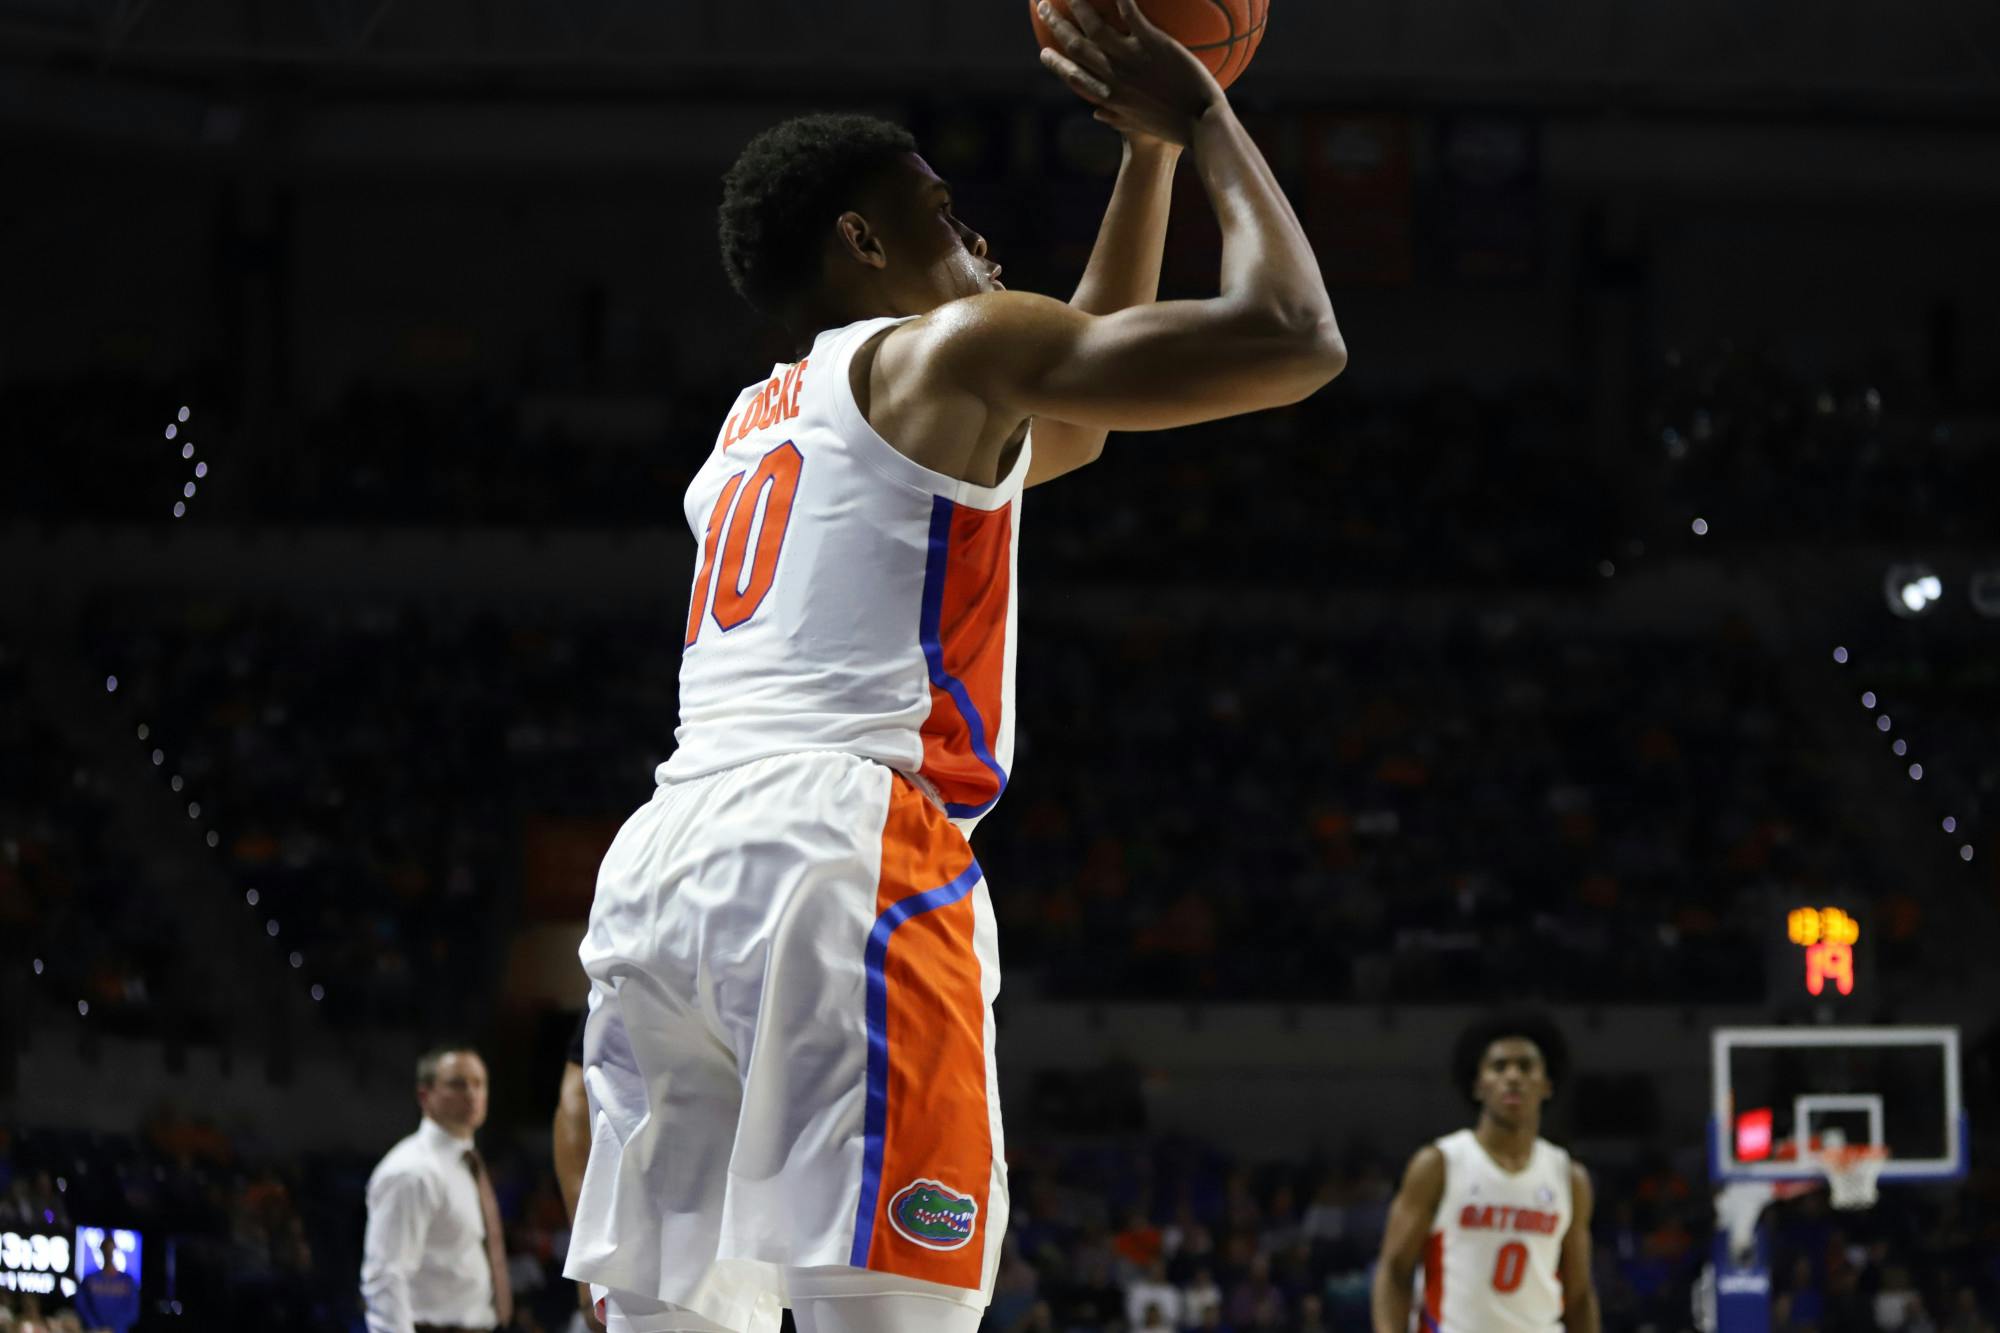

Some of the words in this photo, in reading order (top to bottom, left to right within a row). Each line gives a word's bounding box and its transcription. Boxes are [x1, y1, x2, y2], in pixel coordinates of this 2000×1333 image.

[722, 359, 808, 455] LOCKE
[684, 439, 804, 649] 10
[1491, 1241, 1529, 1294] 0
